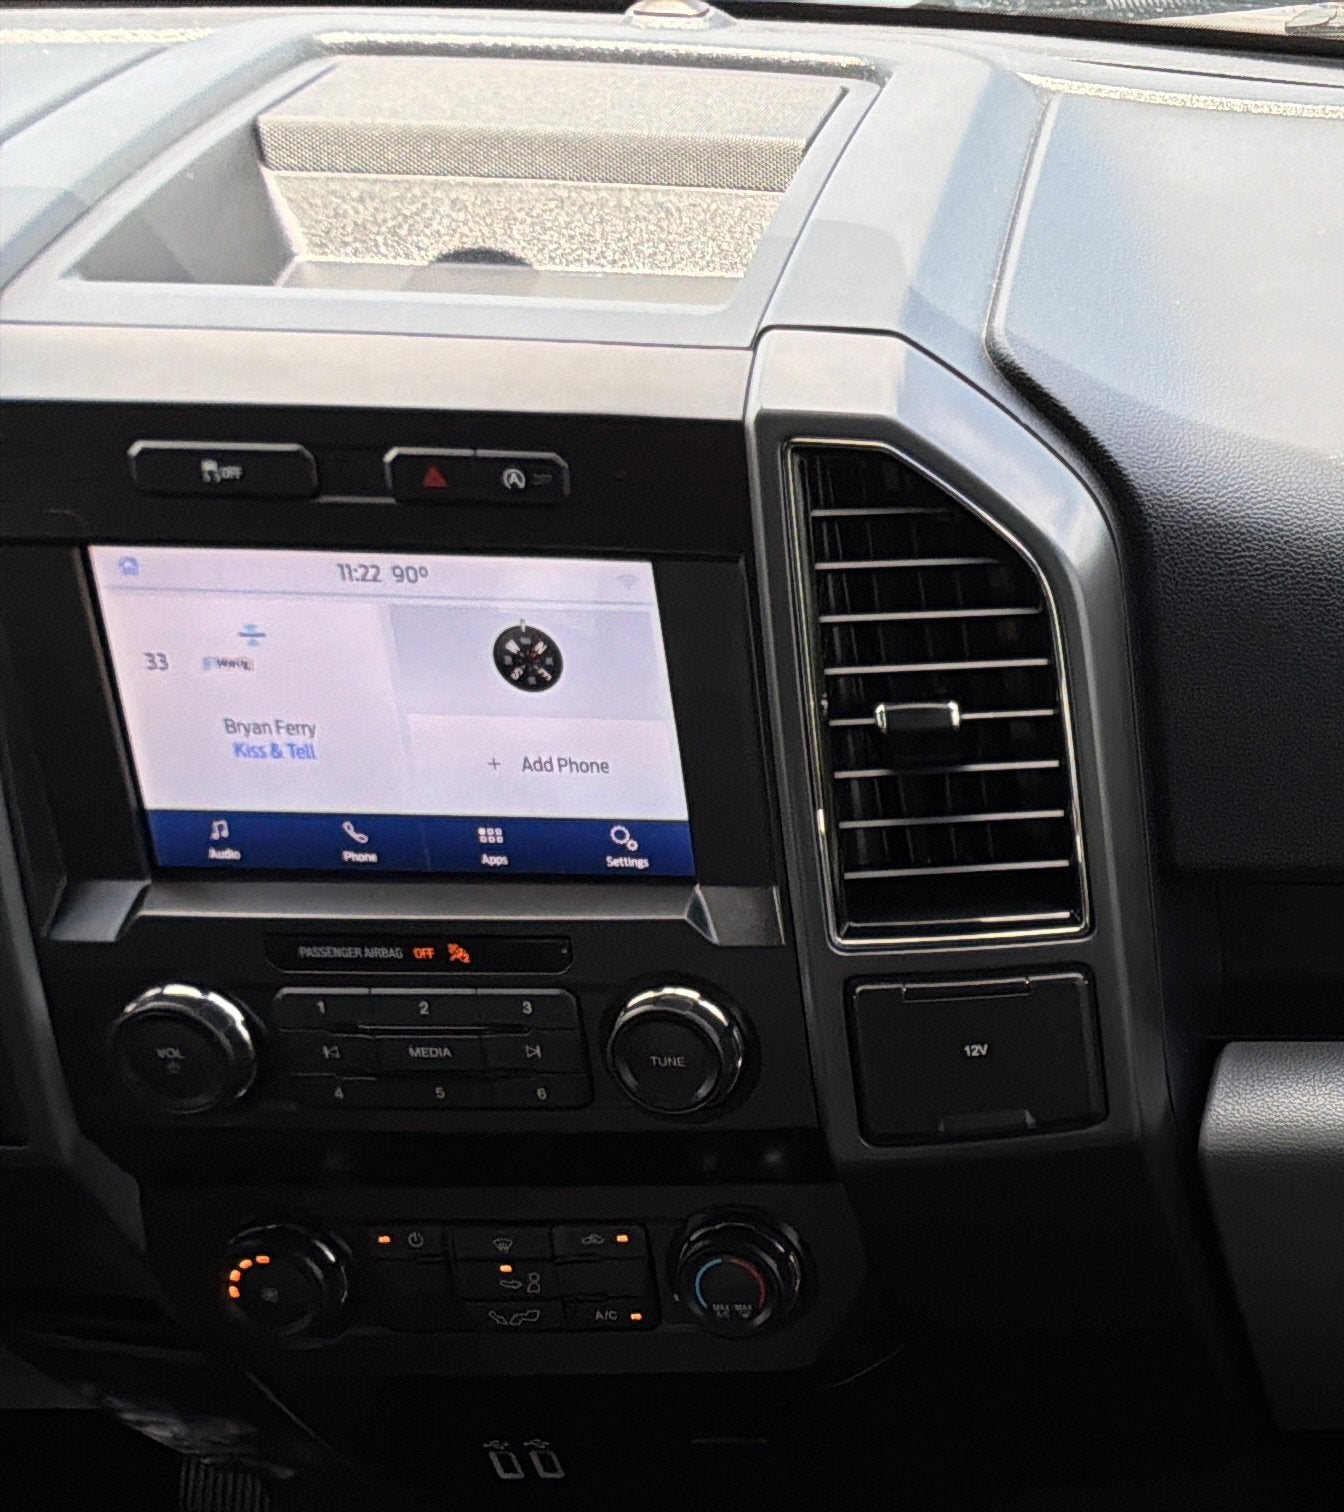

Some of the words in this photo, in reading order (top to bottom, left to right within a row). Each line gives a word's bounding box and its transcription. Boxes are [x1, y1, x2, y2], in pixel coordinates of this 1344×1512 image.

[337, 563, 382, 582] 11:22
[144, 652, 169, 671] 33
[223, 718, 272, 738] Bryan
[275, 719, 317, 739] Ferry
[233, 742, 267, 759] Kiss
[270, 743, 284, 759] &
[286, 743, 317, 760] Tell
[521, 756, 554, 773] Add
[557, 757, 610, 774] Phone
[208, 847, 242, 861] Audio
[342, 850, 378, 863] Phone
[481, 853, 509, 867] Apps
[606, 855, 650, 870] Settings
[298, 946, 363, 959] PASSENGER
[363, 947, 404, 960] AIRBAG
[412, 947, 435, 960] OFF
[316, 1000, 326, 1016] 1
[417, 1001, 430, 1015] 2
[522, 1001, 533, 1015] 3
[156, 1047, 186, 1060] VOL
[408, 1046, 453, 1058] MEDIA
[963, 1043, 989, 1057] 12V
[650, 1055, 686, 1068] TUNE
[334, 1086, 345, 1100] 4
[434, 1086, 446, 1100] 5
[537, 1087, 548, 1101] 6
[594, 1308, 618, 1322] A/C
